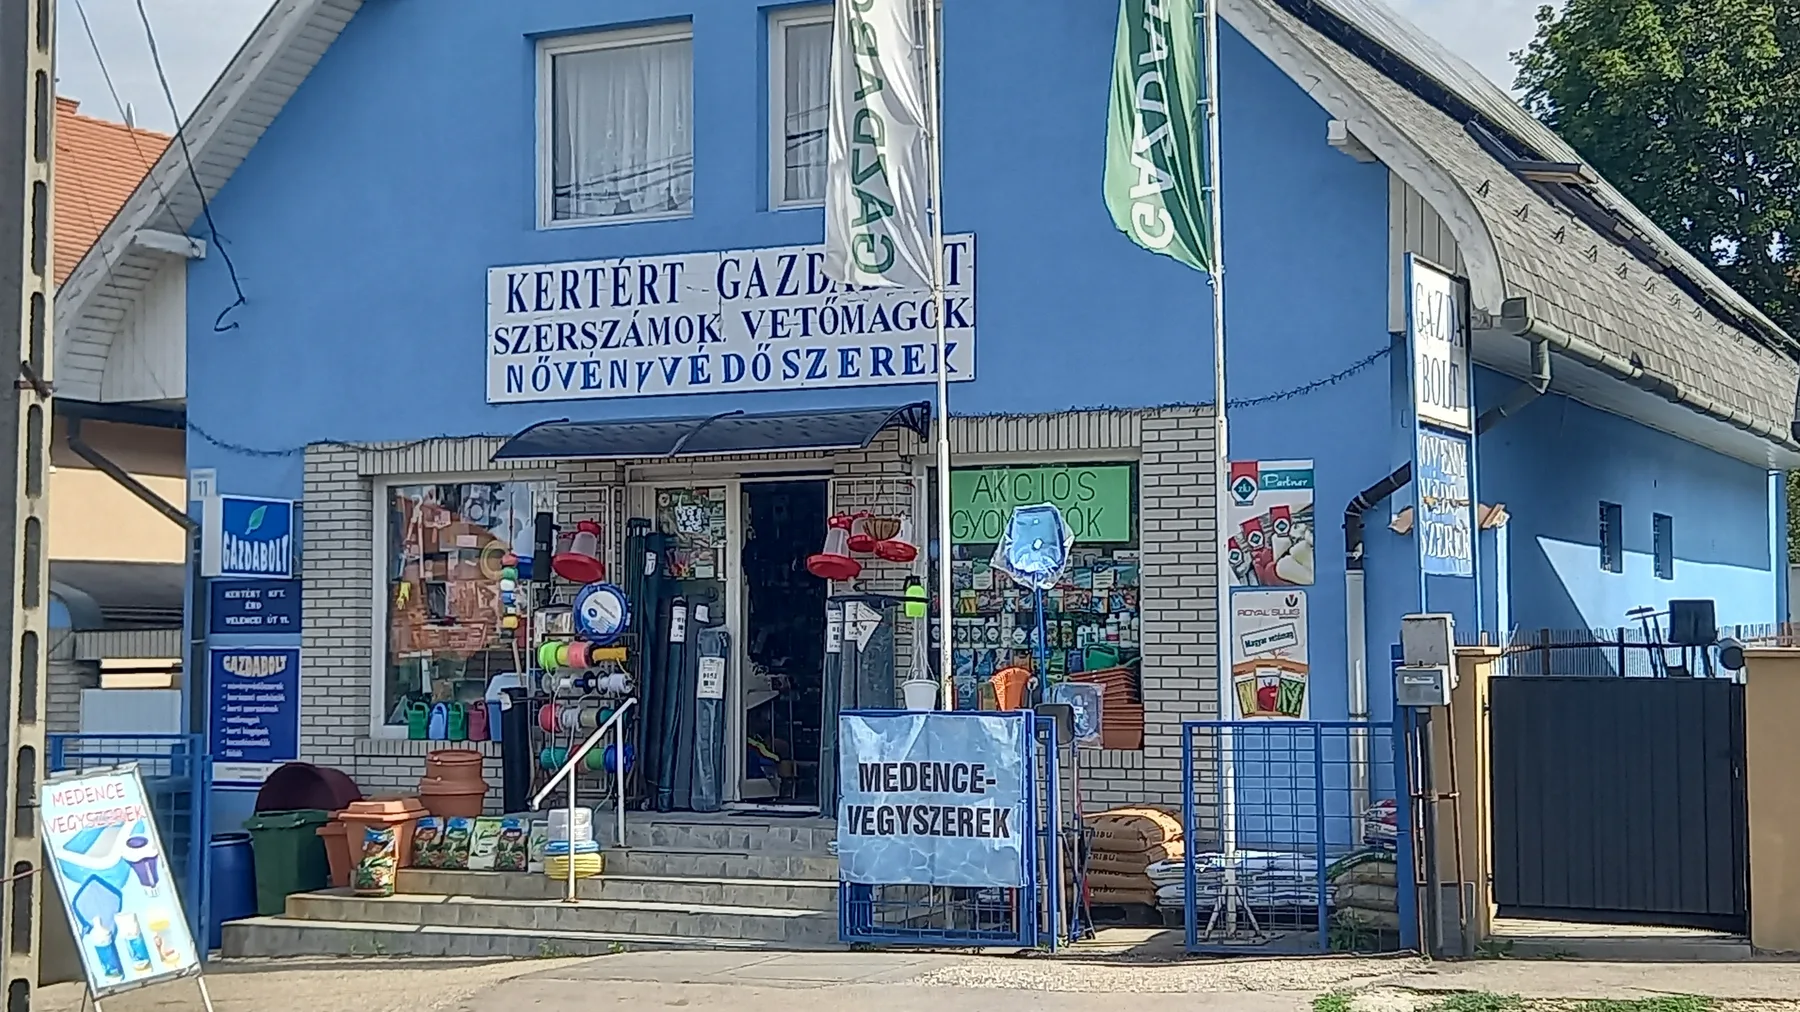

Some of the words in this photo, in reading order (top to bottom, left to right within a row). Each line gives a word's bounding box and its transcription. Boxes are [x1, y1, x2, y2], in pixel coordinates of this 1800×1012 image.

[505, 257, 685, 314] KERTÉRT
[716, 242, 967, 300] GAZDT
[1415, 282, 1464, 348] GAZDA
[1422, 353, 1458, 412] BOLT
[197, 480, 208, 497] 11
[971, 469, 1097, 503] AKCIÓS
[1262, 473, 1308, 487] Partner
[222, 530, 289, 573] GAZDABOLT
[222, 655, 287, 678] GAZDABOLT
[858, 762, 996, 794] MEDENCE-
[52, 782, 126, 807] MEDENCE
[48, 805, 147, 833] VEGYSZEREK
[847, 805, 1011, 838] VEGYSZEREK
